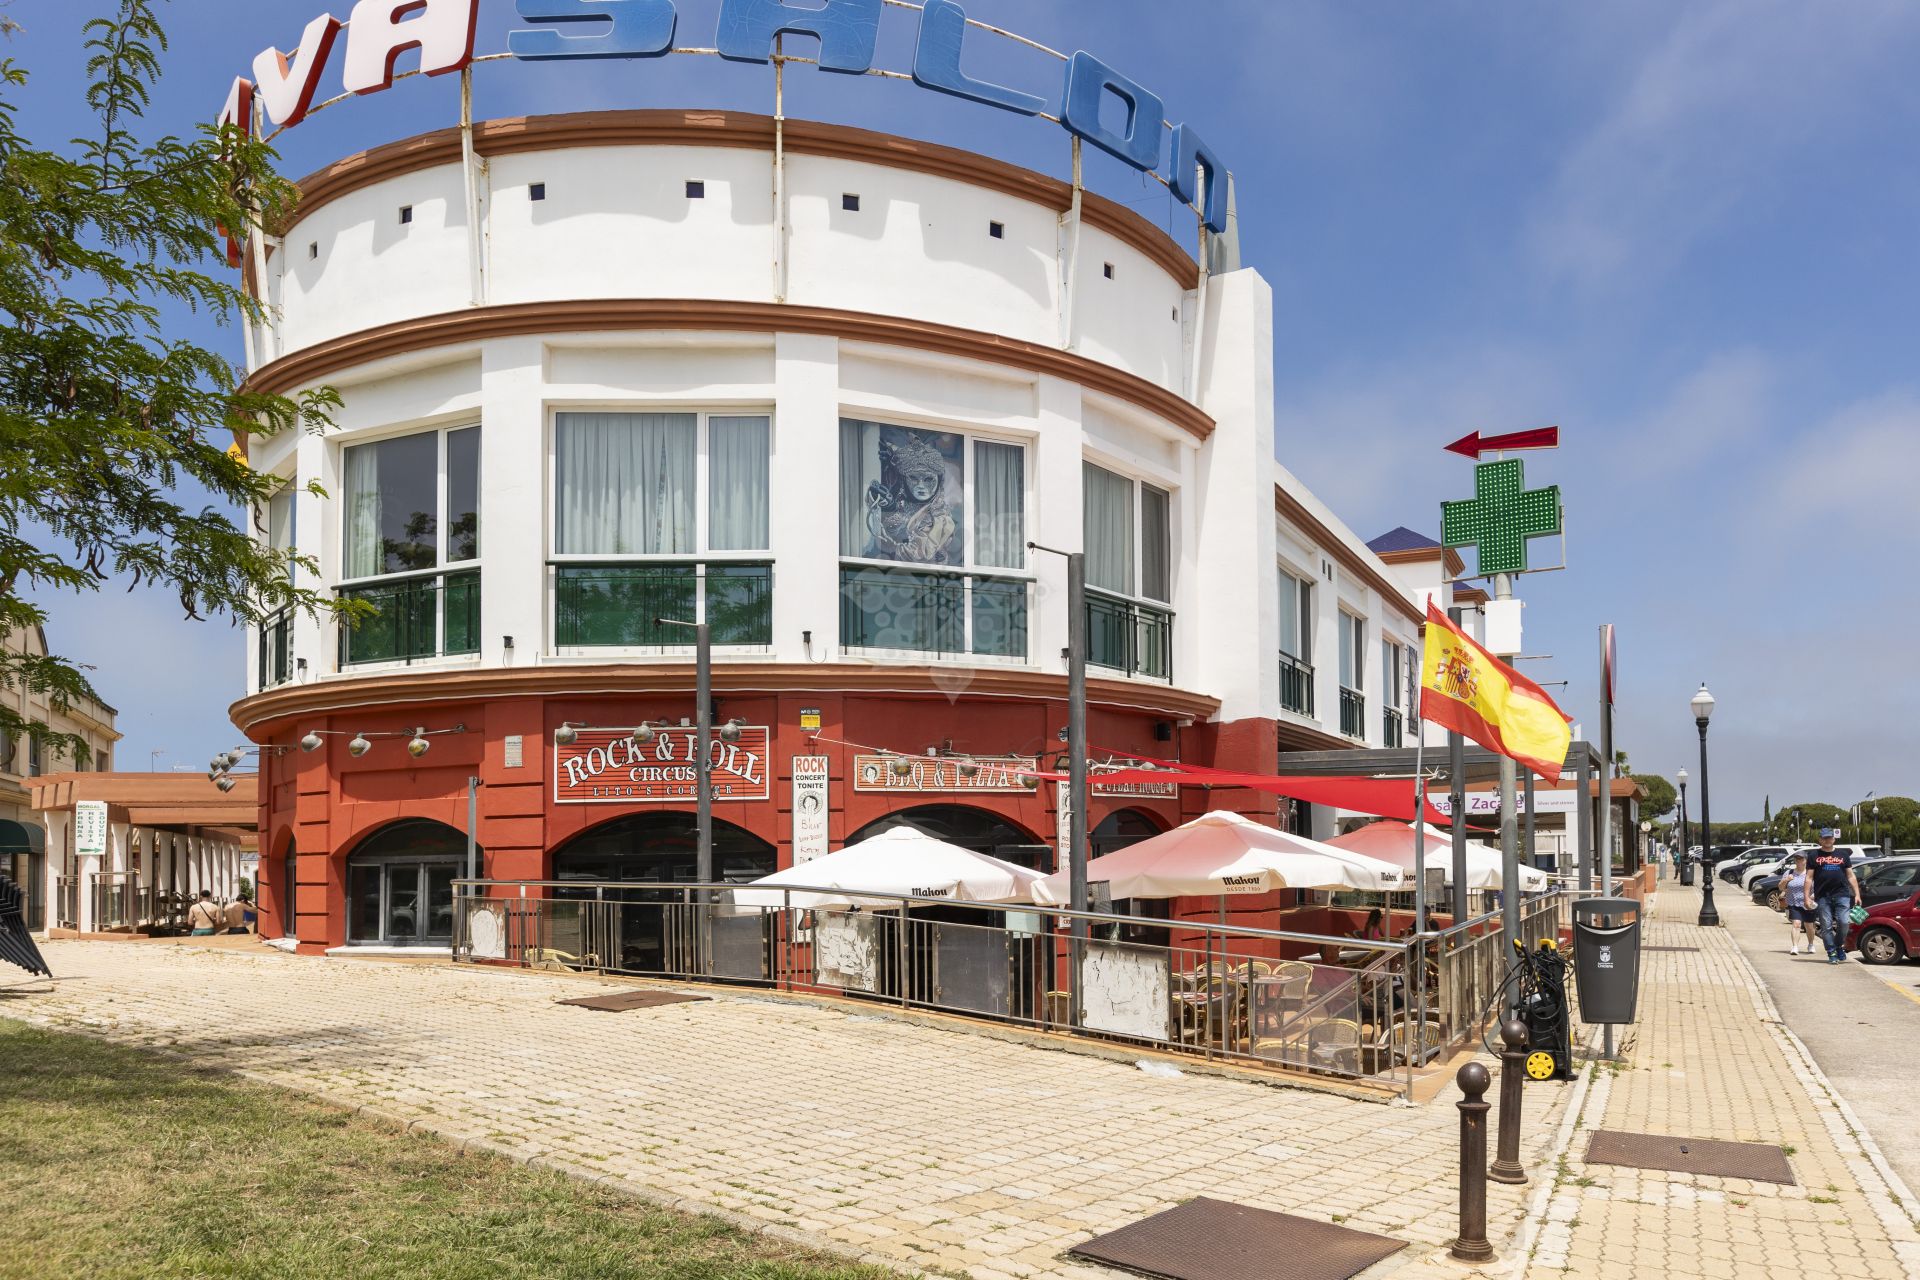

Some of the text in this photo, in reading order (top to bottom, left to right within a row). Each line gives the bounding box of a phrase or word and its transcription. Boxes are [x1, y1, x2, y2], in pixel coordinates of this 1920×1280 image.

[562, 735, 646, 788] ROCK
[655, 732, 674, 761] &
[795, 757, 826, 773] ROCK
[629, 767, 697, 782] CIRCUS
[934, 762, 945, 787] &
[593, 784, 732, 797] LITO'S CORER
[1222, 876, 1260, 885] Mahou
[911, 887, 948, 897] Mahou
